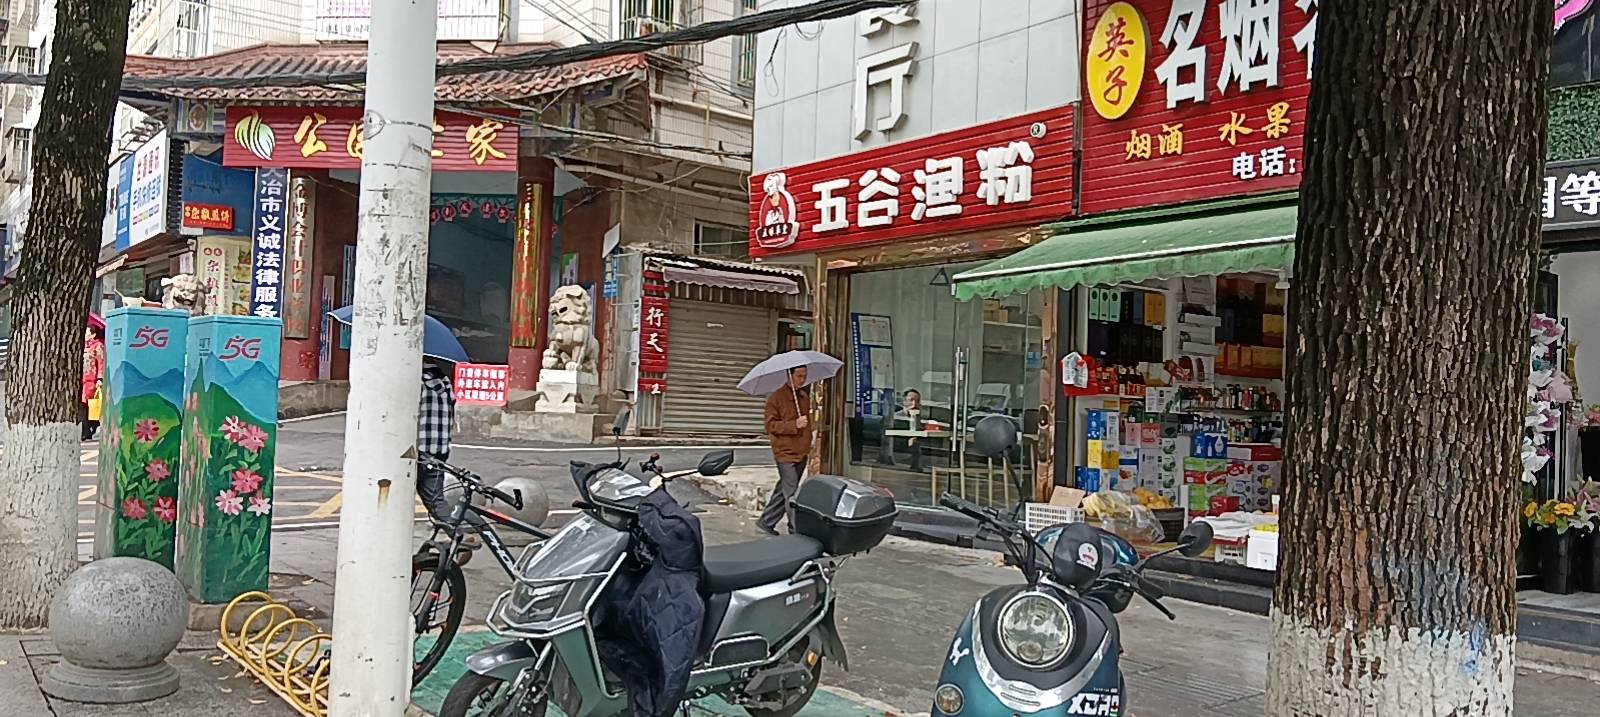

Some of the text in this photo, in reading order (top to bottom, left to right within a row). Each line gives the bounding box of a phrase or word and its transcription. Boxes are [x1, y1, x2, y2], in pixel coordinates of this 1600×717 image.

[855, 7, 920, 142] 厅
[1098, 16, 1134, 106] 英子
[293, 112, 505, 165] 公家
[1125, 102, 1290, 160] 烟酒 水果
[812, 141, 1034, 233] 五谷渔粉
[129, 326, 169, 349] 5G
[218, 336, 261, 359] 5G
